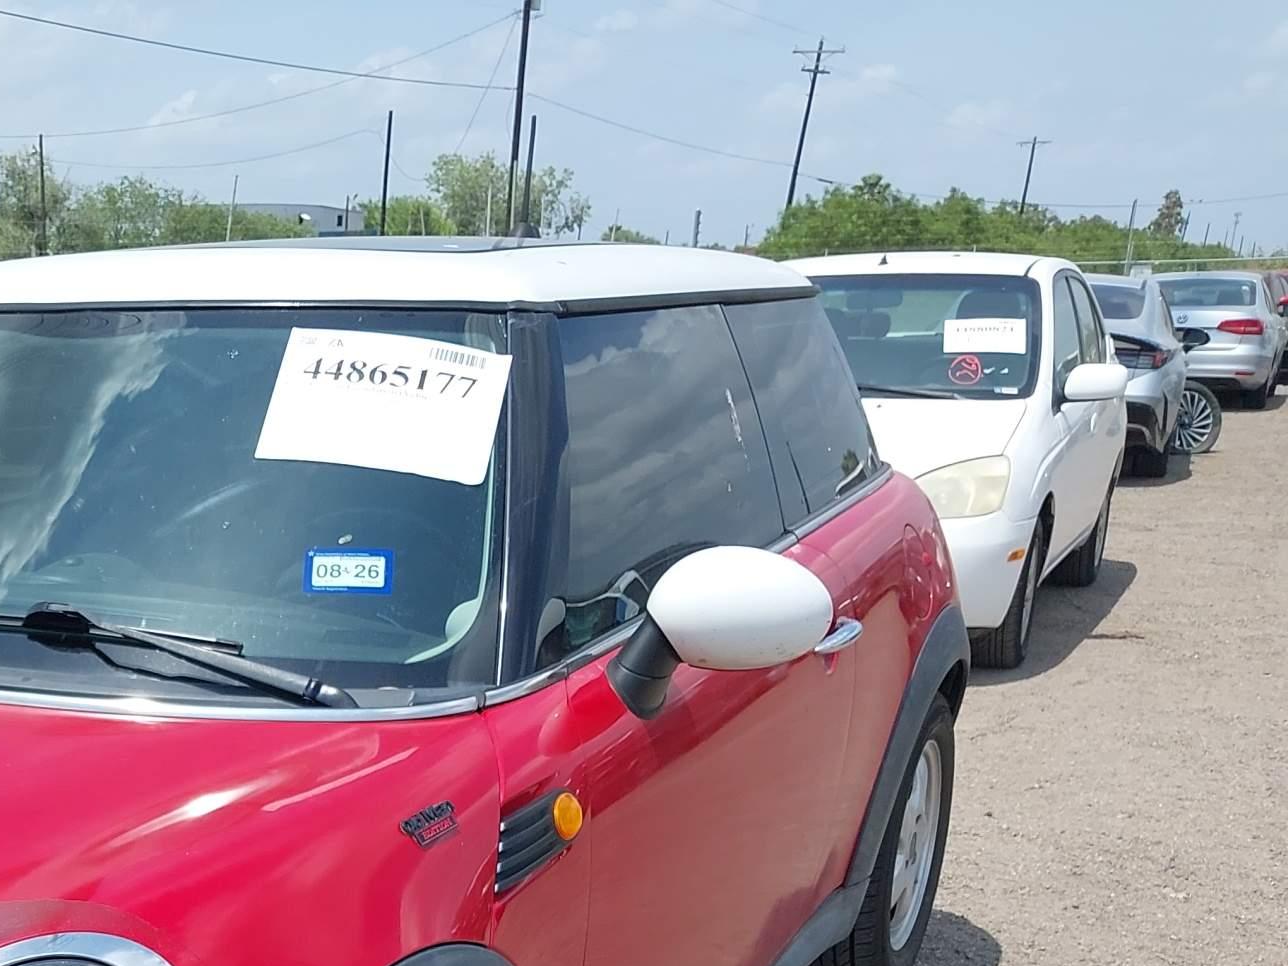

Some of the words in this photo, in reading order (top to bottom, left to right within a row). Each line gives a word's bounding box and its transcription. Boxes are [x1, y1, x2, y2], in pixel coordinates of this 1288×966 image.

[303, 357, 479, 399] 44865177
[316, 564, 342, 578] 08
[354, 564, 379, 579] 26
